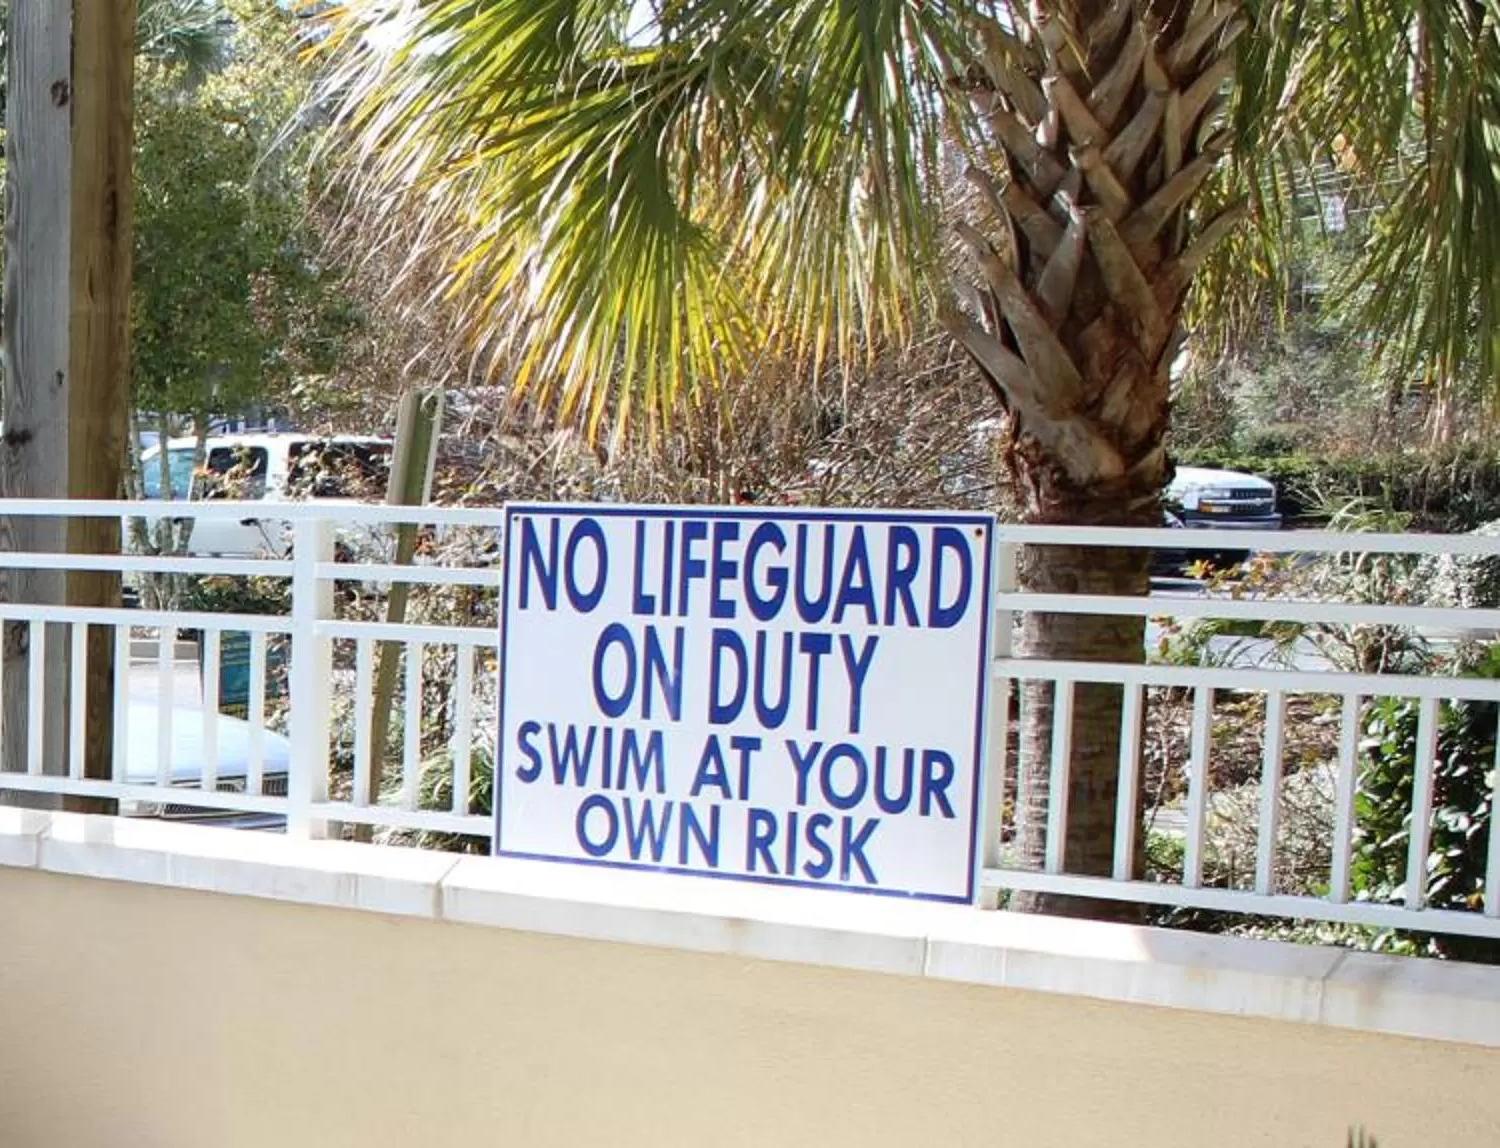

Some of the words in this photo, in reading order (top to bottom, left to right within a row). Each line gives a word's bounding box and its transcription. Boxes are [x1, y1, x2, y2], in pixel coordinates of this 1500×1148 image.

[518, 517, 608, 614] NO
[631, 519, 974, 630] LIFEGUARD
[592, 622, 685, 723] ON
[708, 626, 880, 734] DUTY
[515, 720, 667, 795] SWIM
[690, 733, 763, 802] AT
[786, 739, 957, 820] YOUR
[575, 793, 722, 868] OWN
[746, 806, 881, 886] RISK
